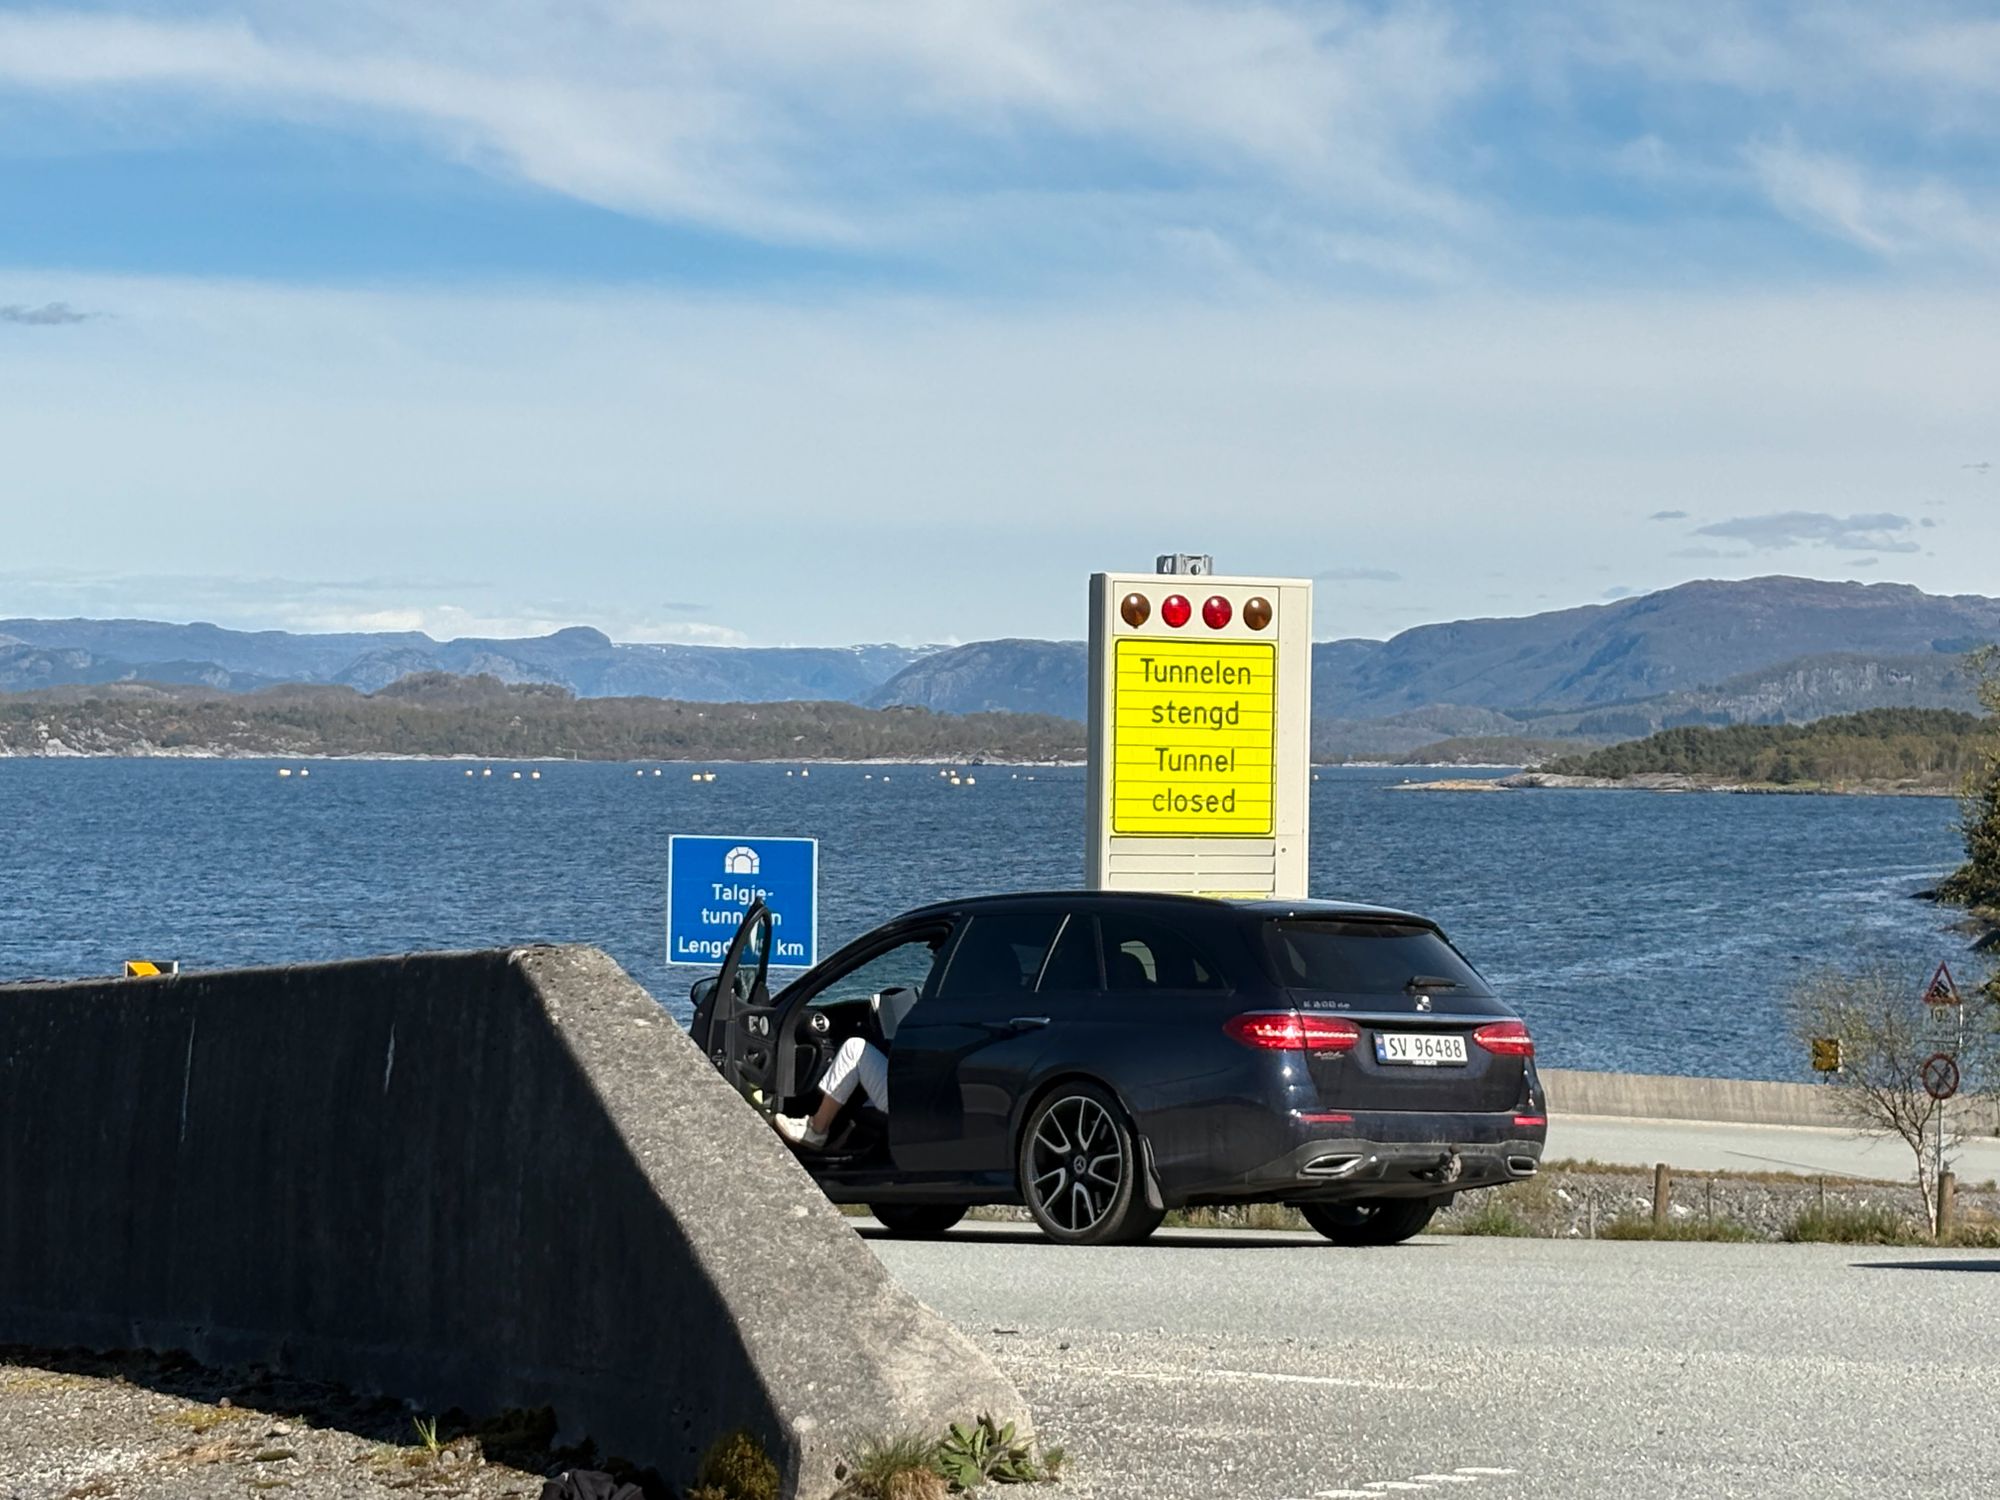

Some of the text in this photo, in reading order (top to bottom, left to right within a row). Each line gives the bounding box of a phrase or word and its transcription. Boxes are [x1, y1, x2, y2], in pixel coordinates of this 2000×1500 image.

[1140, 658, 1251, 685] Tunnelen
[1151, 701, 1239, 730] stengd
[1154, 747, 1236, 772] Tunnel
[1152, 788, 1236, 813] closed
[712, 883, 774, 906] Talgje-
[702, 908, 782, 926] tunnn
[777, 939, 804, 956] km
[1389, 1037, 1407, 1056] SV
[1415, 1038, 1463, 1058] 96488
